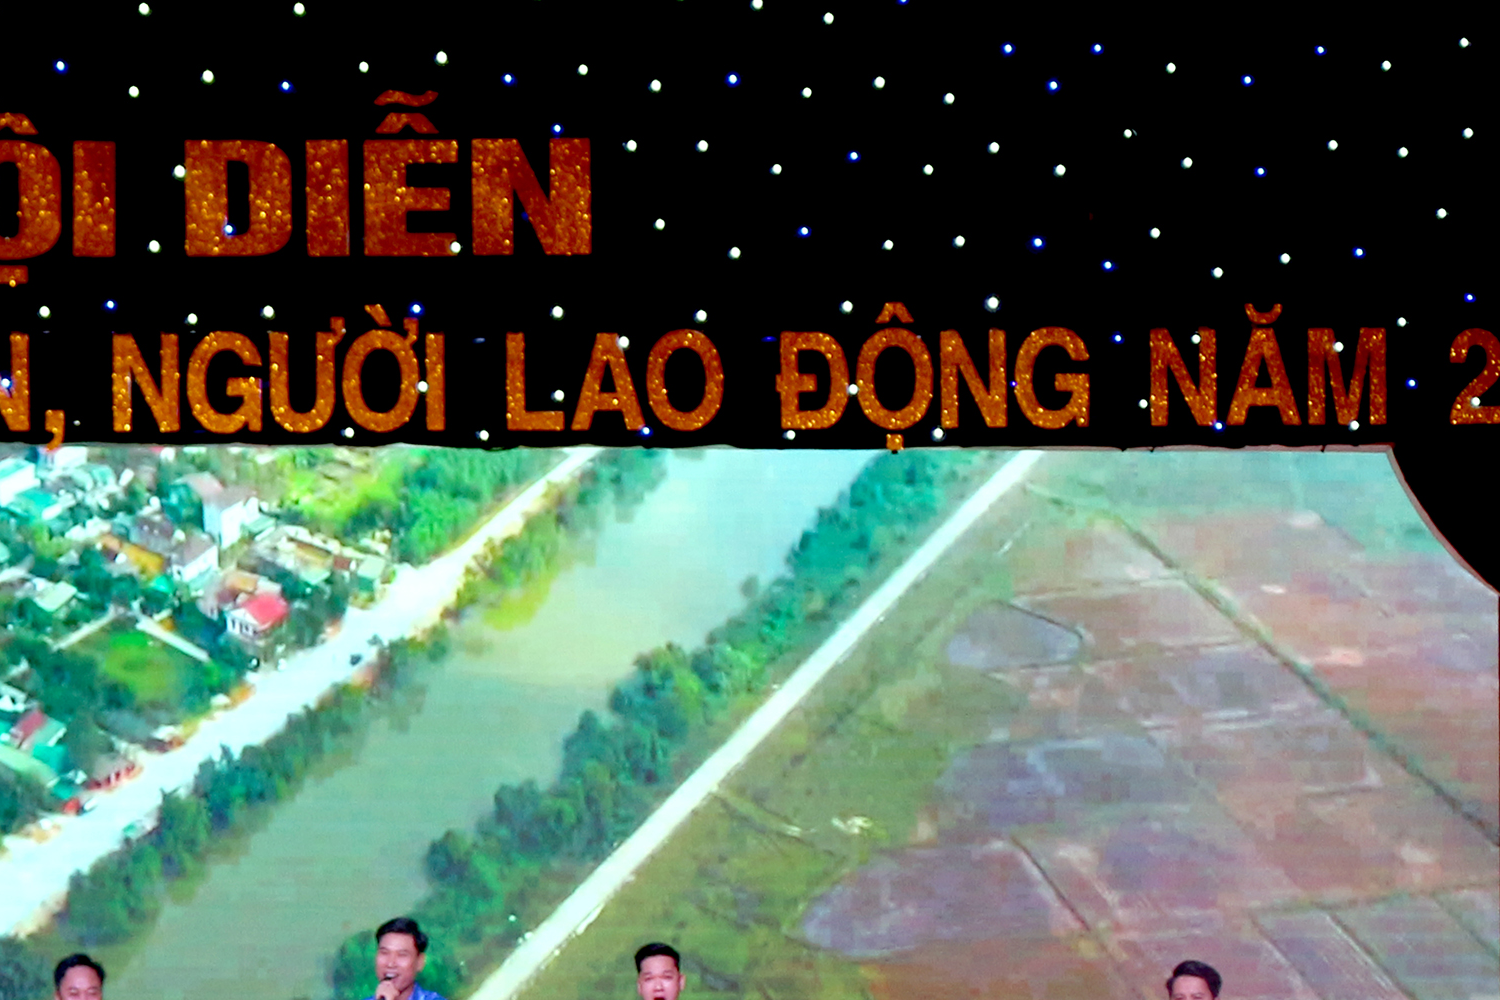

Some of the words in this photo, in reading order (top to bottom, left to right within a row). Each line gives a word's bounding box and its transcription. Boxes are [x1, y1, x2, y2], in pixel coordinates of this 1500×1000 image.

[184, 90, 592, 257] DIỄN
[111, 304, 446, 433] NGƯỜI
[505, 329, 725, 432] LAO
[775, 302, 1090, 451] ĐỘNG
[1149, 303, 1388, 426] NĂM
